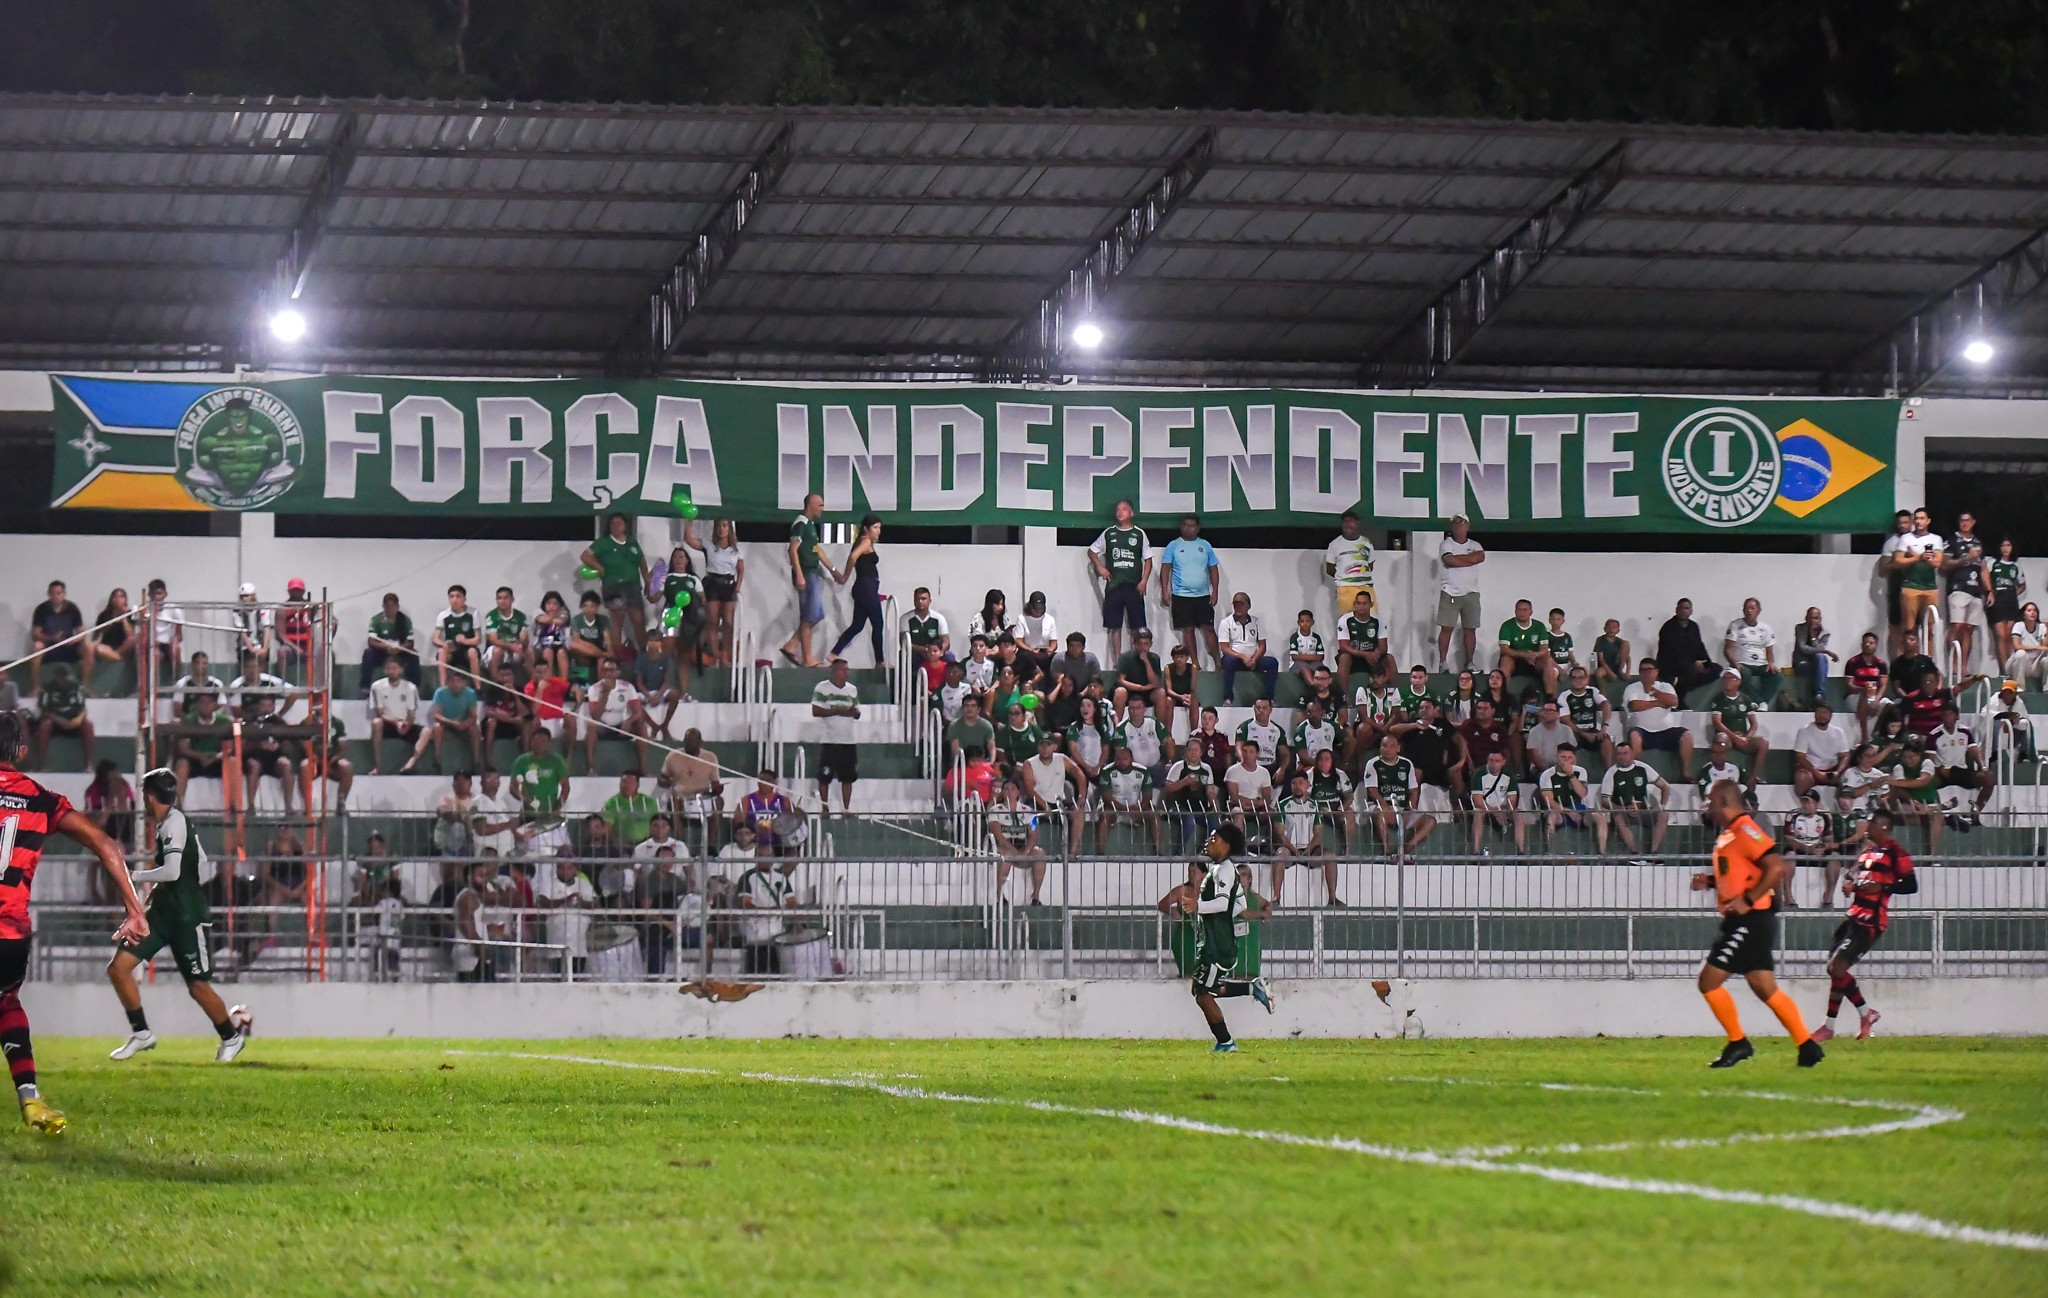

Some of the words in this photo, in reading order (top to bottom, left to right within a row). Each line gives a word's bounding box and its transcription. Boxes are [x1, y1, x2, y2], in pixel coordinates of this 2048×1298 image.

[322, 390, 722, 510] FORÇA
[776, 401, 1640, 520] INDEPENDENTE
[1708, 430, 1735, 477] I
[1668, 458, 1775, 521] INDEPENDENTE
